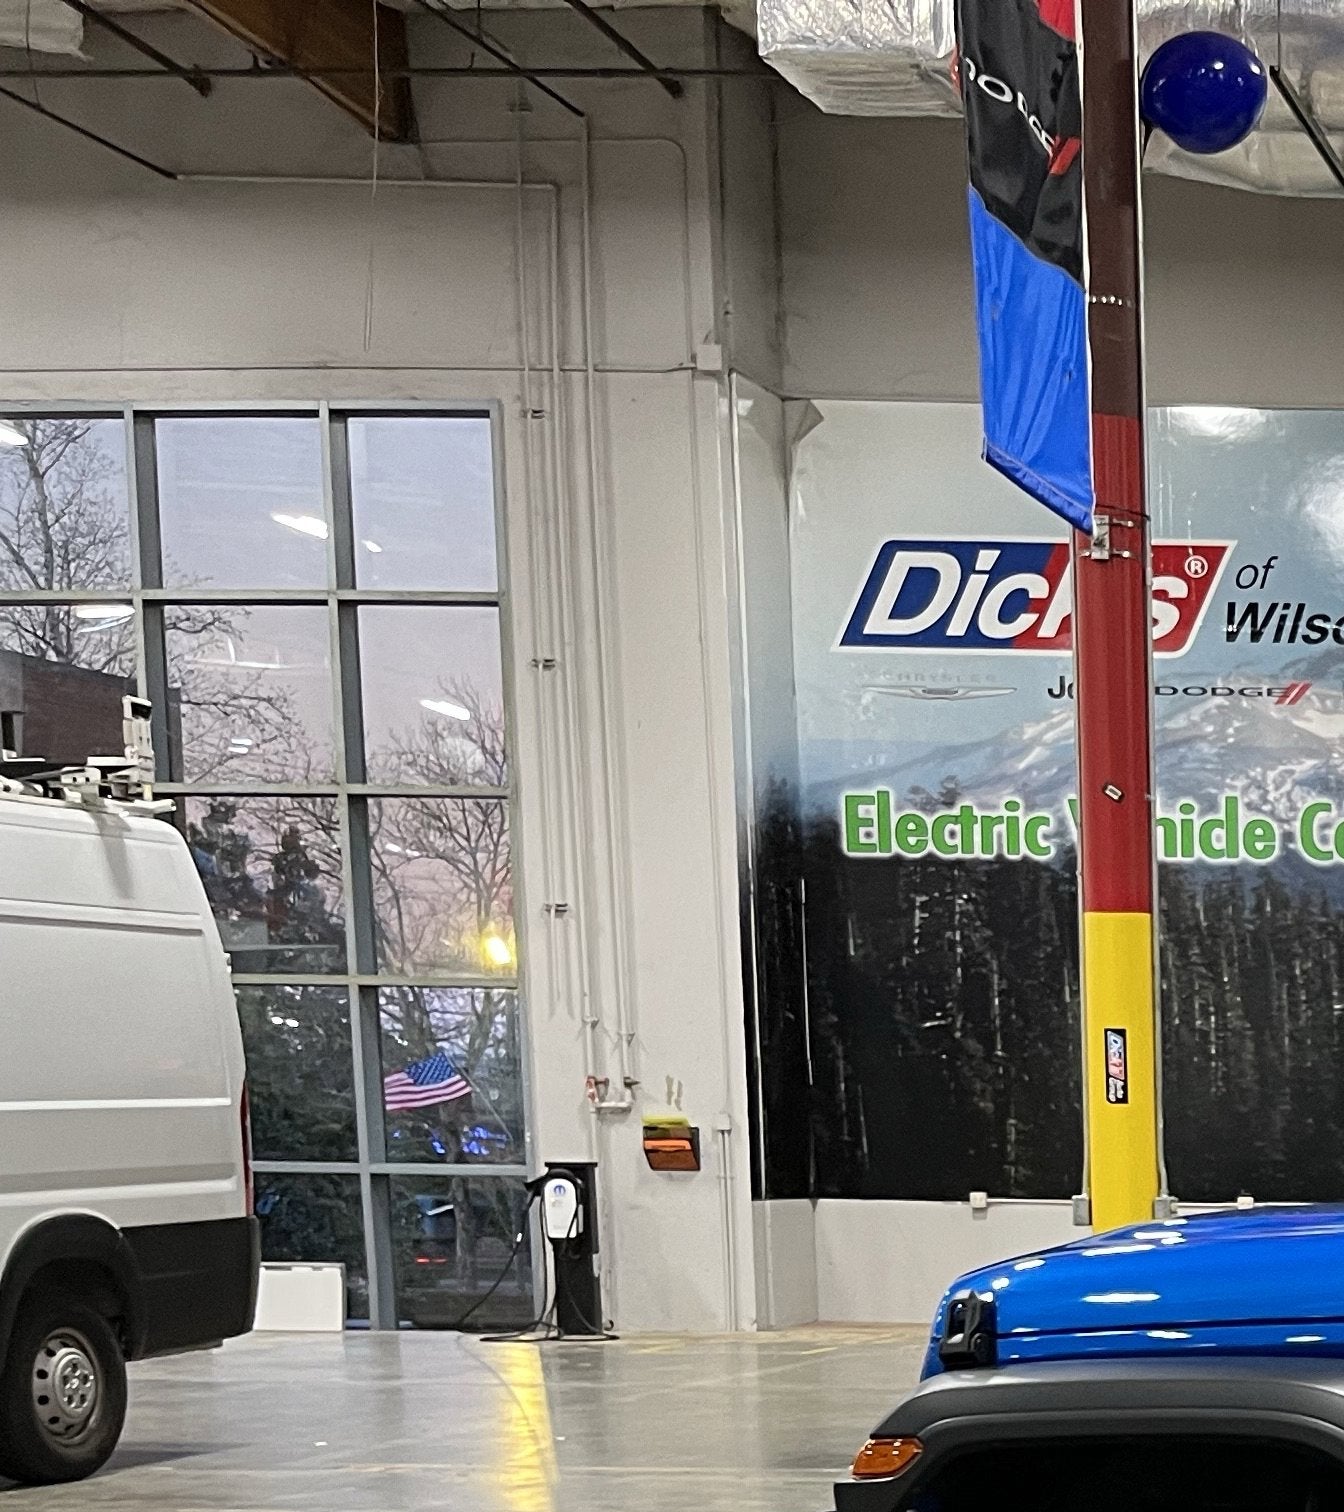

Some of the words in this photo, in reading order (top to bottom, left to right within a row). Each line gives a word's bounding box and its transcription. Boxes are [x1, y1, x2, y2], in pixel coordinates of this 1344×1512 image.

[863, 549, 1188, 640] Dics
[1235, 556, 1278, 589] of
[1154, 685, 1292, 698] DODGE
[845, 790, 1051, 855] Electric
[1068, 796, 1276, 860] hicle
